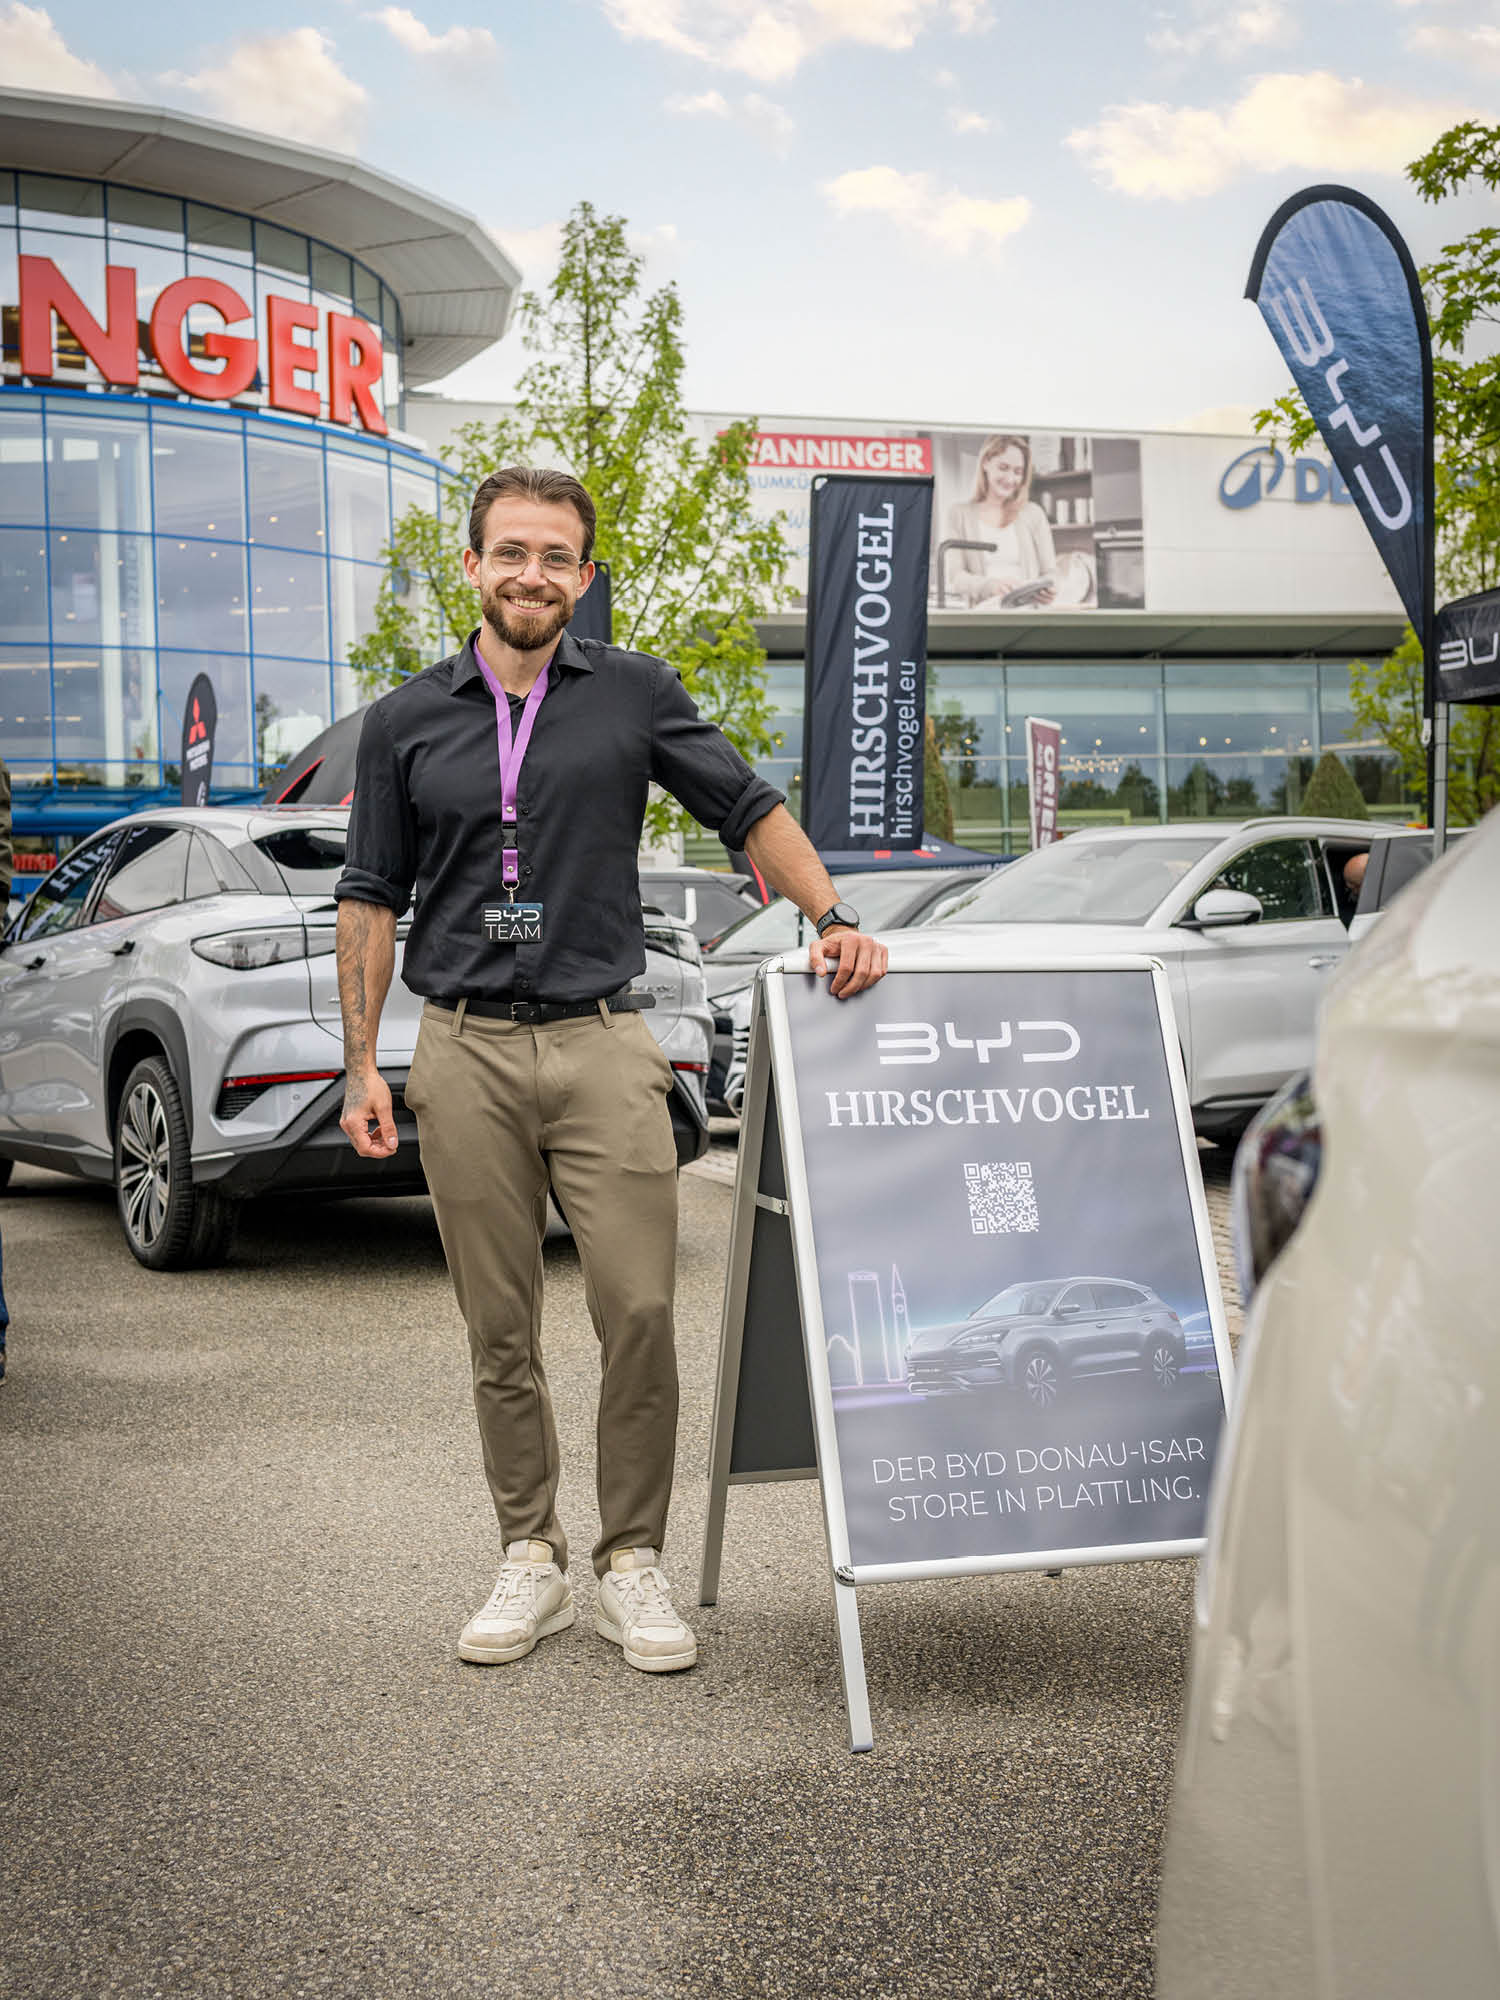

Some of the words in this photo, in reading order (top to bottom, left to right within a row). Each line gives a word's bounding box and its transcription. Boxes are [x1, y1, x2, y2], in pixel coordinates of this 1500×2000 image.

[18, 253, 389, 436] NGER
[1270, 276, 1413, 531] BYD
[850, 503, 894, 838] HIRSCHVOGEL
[890, 660, 919, 839] hirschvogel.eu
[484, 909, 541, 922] BYD
[484, 924, 541, 940] TEAM
[875, 1021, 1081, 1065] BYD
[825, 1085, 1150, 1127] HIRSCHVOGEL
[872, 1455, 937, 1484] DER
[946, 1451, 1007, 1479] BYD
[1016, 1437, 1206, 1474] DONAU-ISAR
[888, 1490, 989, 1522] STORE
[996, 1487, 1026, 1513] IN
[1036, 1475, 1201, 1511] PLATTLING.
